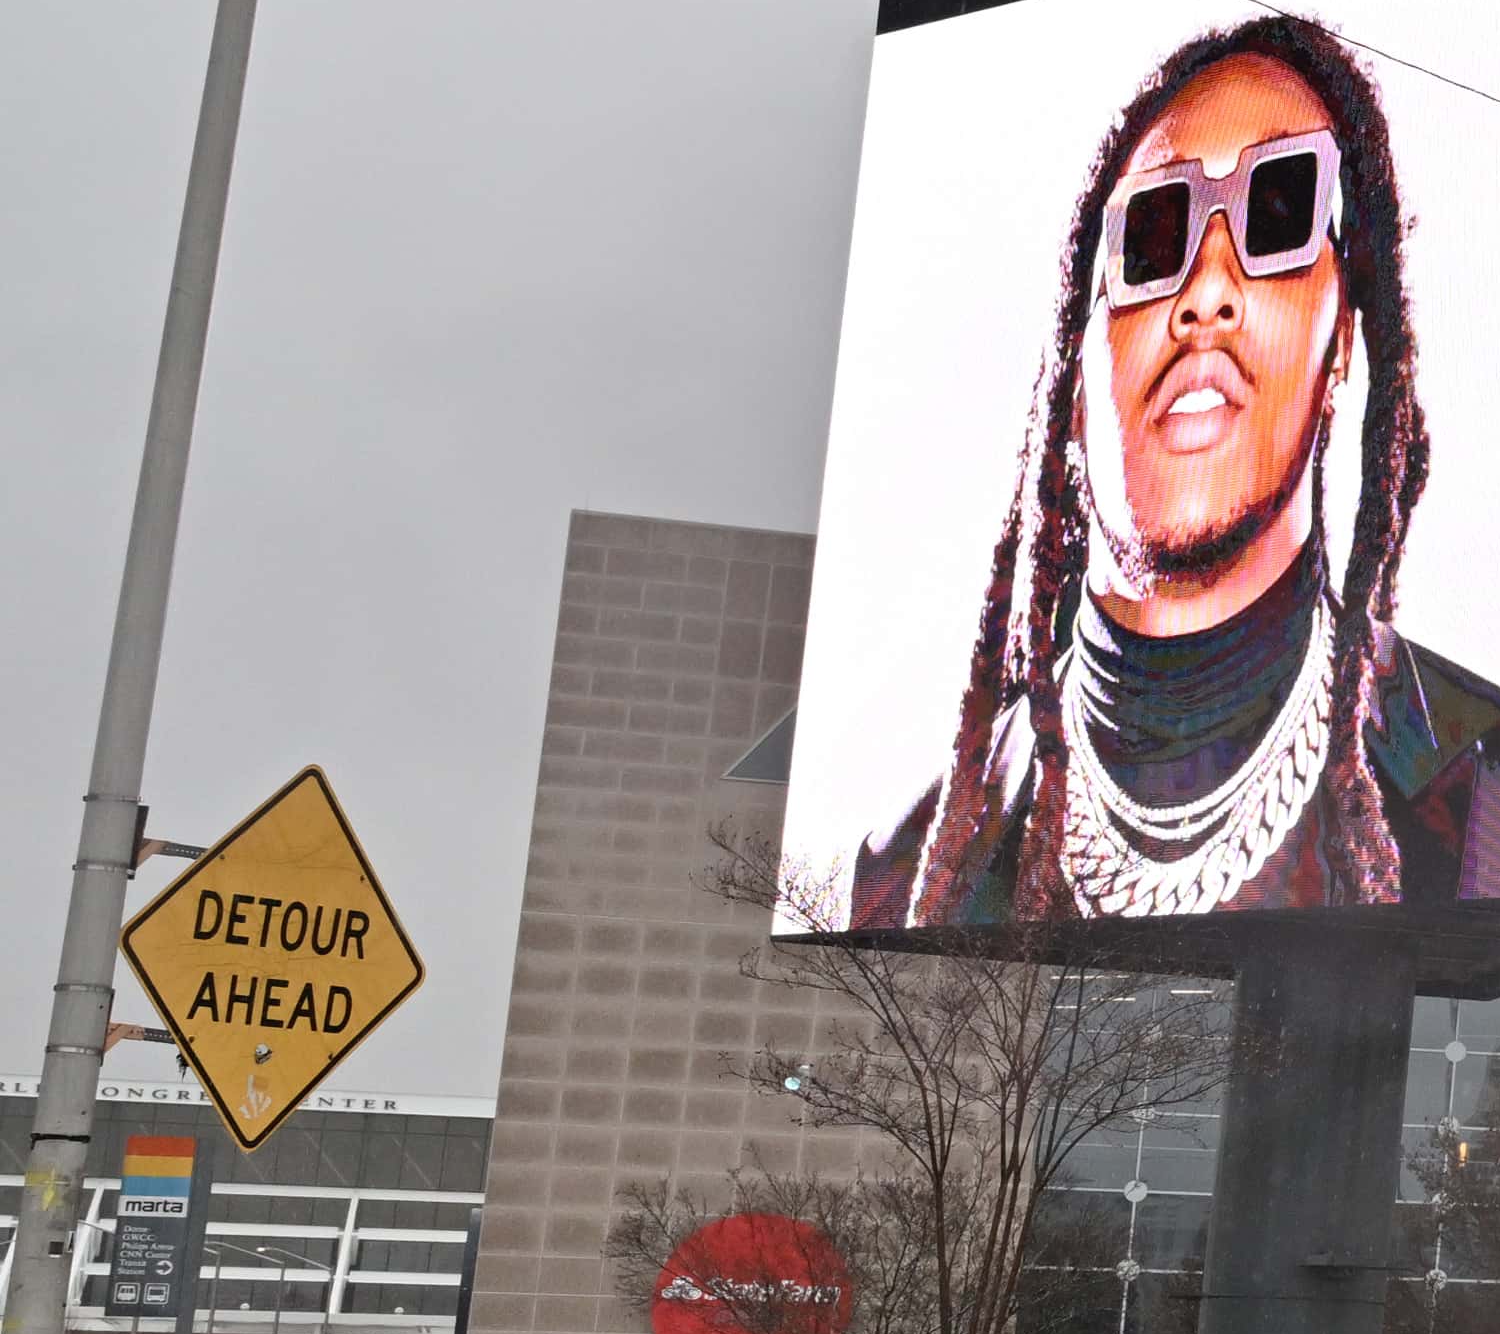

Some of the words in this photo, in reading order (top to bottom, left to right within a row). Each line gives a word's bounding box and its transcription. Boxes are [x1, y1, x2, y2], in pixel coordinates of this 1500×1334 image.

[193, 889, 370, 960] DETOUR
[186, 971, 353, 1034] AHEAD
[125, 1200, 183, 1213] marta
